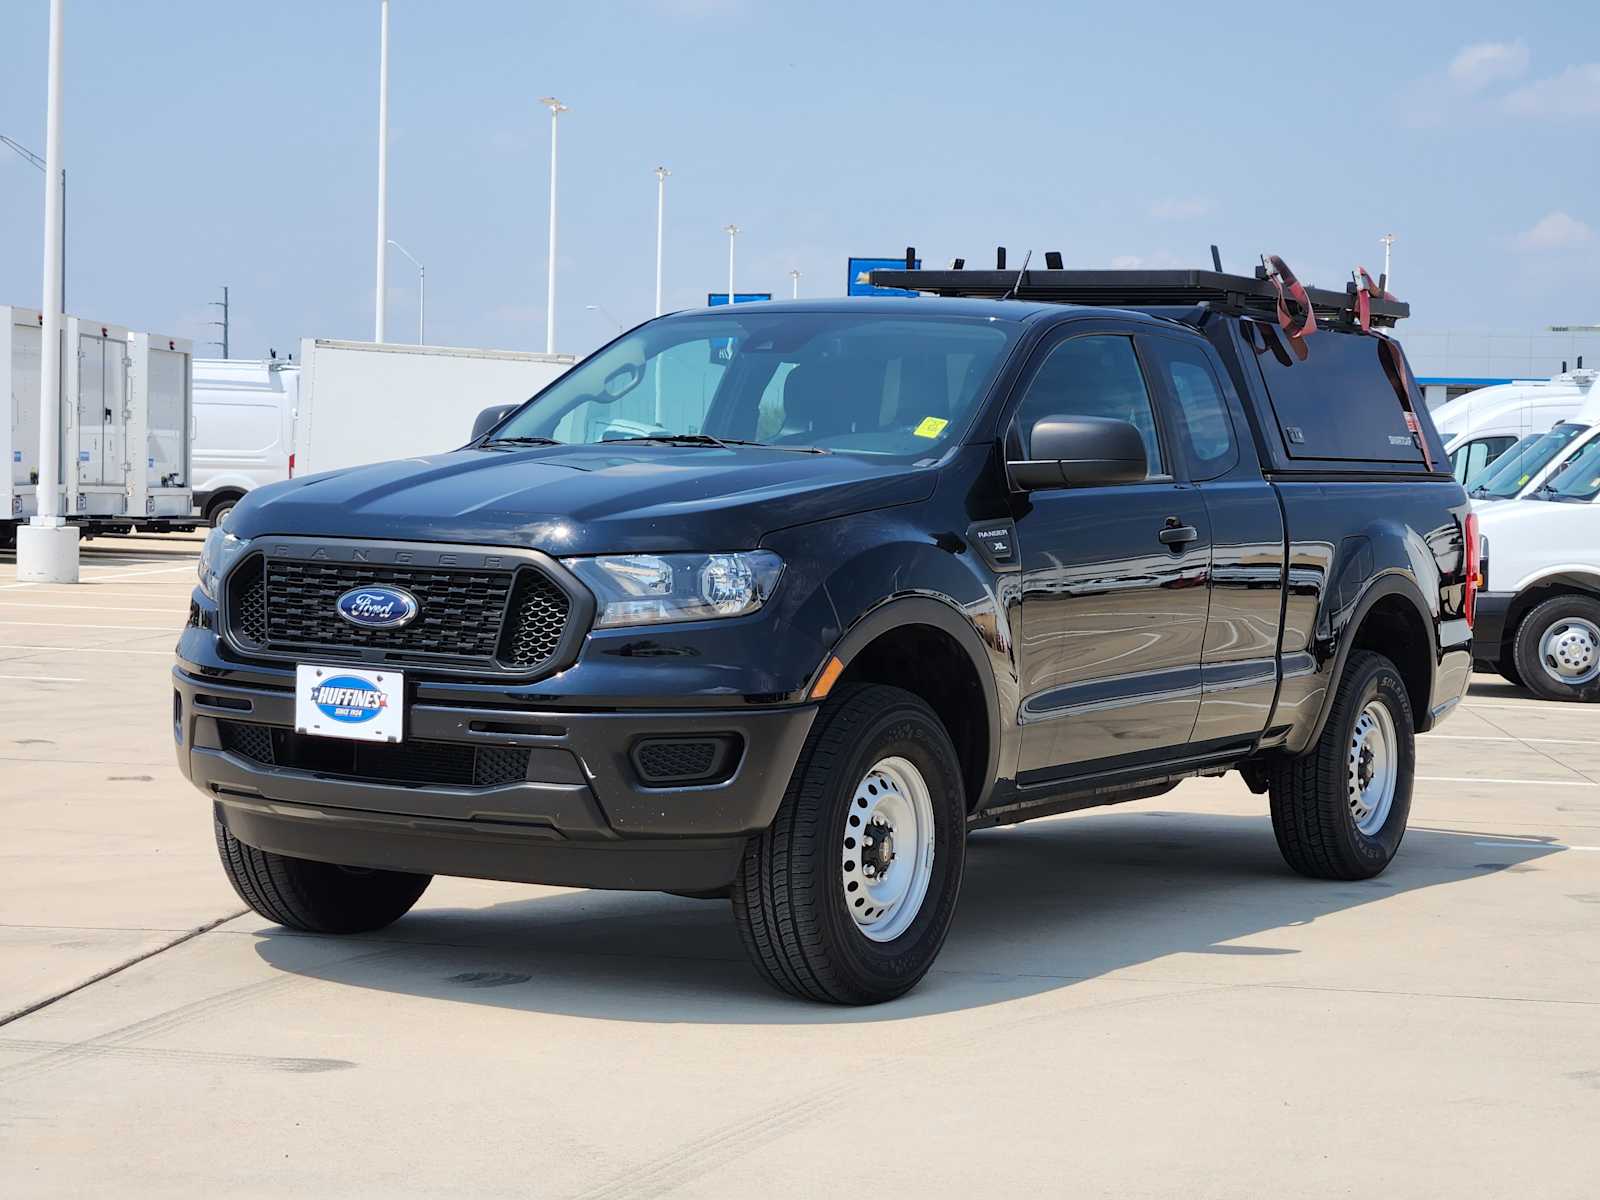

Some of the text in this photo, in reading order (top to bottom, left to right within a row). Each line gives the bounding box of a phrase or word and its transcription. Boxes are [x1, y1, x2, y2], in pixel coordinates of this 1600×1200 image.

[977, 529, 1008, 538] RANGER
[273, 544, 504, 568] RANGER
[993, 542, 1007, 550] XL
[351, 593, 394, 618] Ford
[317, 686, 382, 708] HUFFINES
